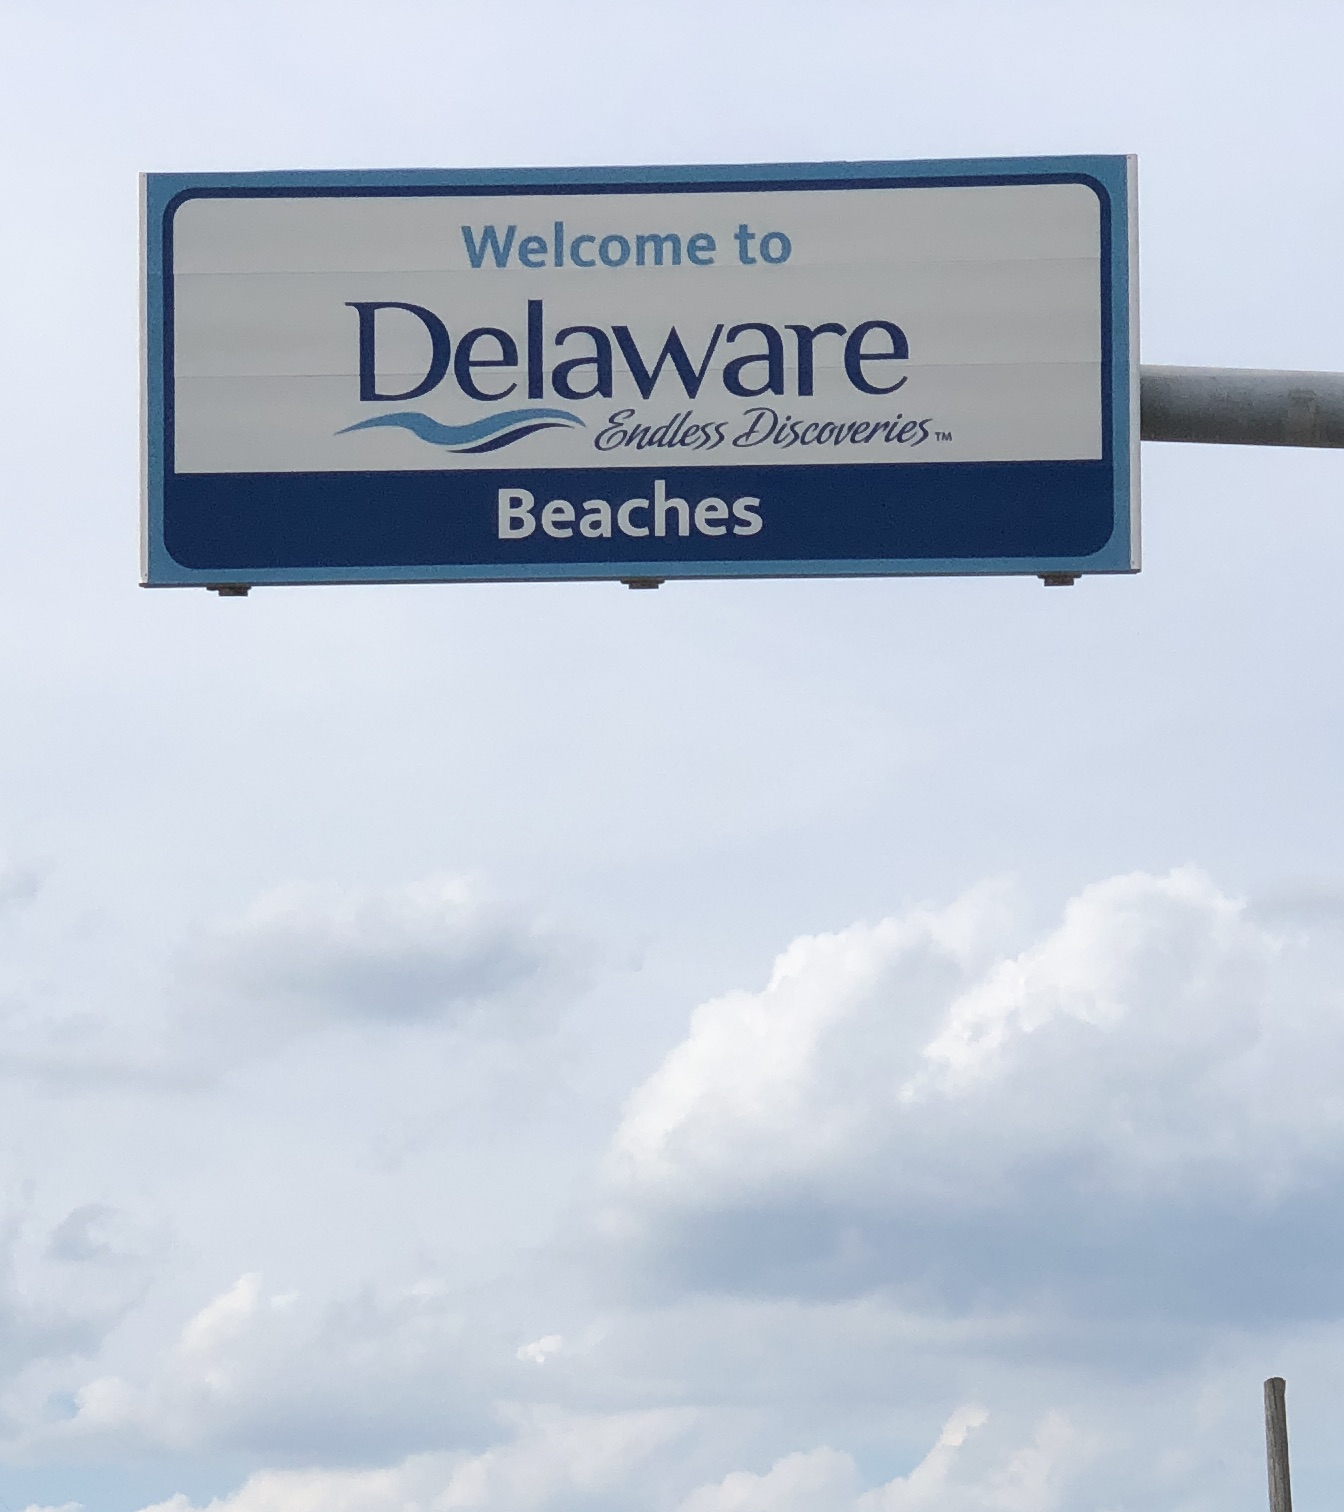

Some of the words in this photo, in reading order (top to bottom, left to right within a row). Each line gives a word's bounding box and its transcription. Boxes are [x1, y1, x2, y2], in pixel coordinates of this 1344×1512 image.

[461, 220, 718, 271] Welcome
[733, 221, 794, 267] to
[344, 298, 911, 403] Delaware
[593, 409, 727, 455] Endless
[732, 405, 933, 452] Discoveries
[496, 480, 765, 542] Beaches
